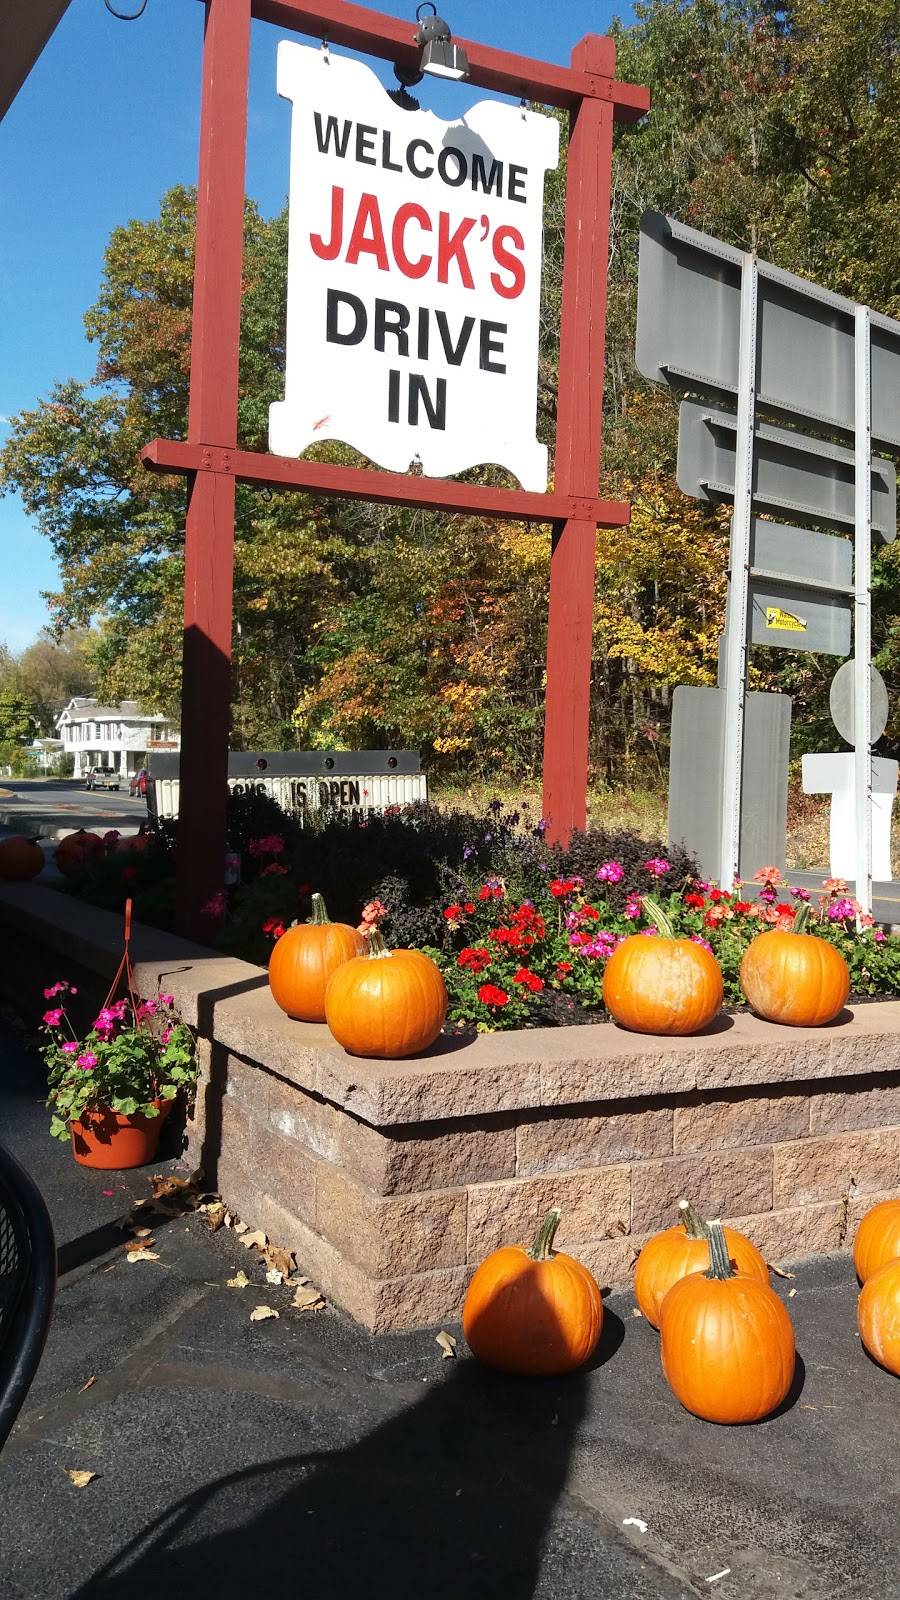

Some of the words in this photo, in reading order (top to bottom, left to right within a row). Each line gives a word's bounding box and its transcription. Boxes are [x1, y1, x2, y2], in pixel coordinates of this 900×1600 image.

[313, 111, 528, 204] WELCOME
[309, 186, 527, 300] JACK'S
[326, 288, 508, 375] DRIVE
[388, 369, 447, 431] IN
[291, 781, 307, 807] IS
[319, 781, 360, 806] OPEN
